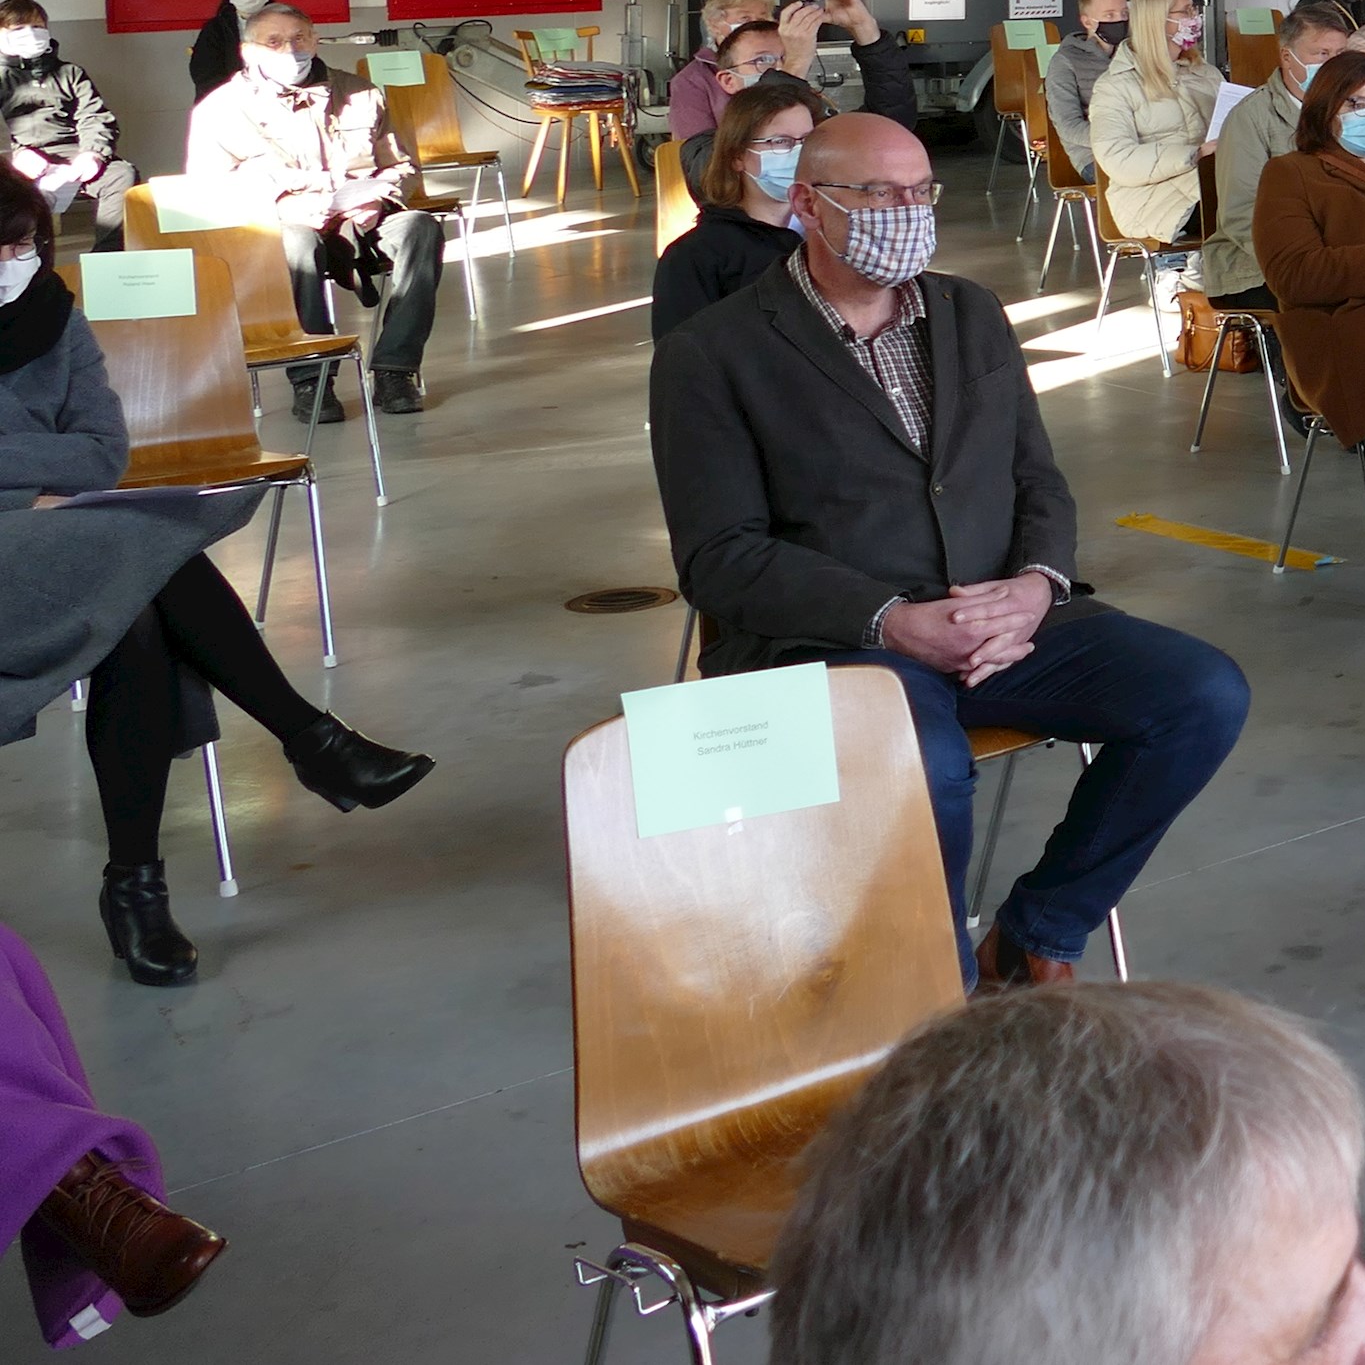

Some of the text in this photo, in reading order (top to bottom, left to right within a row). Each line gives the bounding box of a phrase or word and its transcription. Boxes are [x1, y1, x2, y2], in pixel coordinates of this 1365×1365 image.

[693, 721, 769, 740] Kirchenvorstand
[697, 737, 768, 756] Sandra Hüttner
